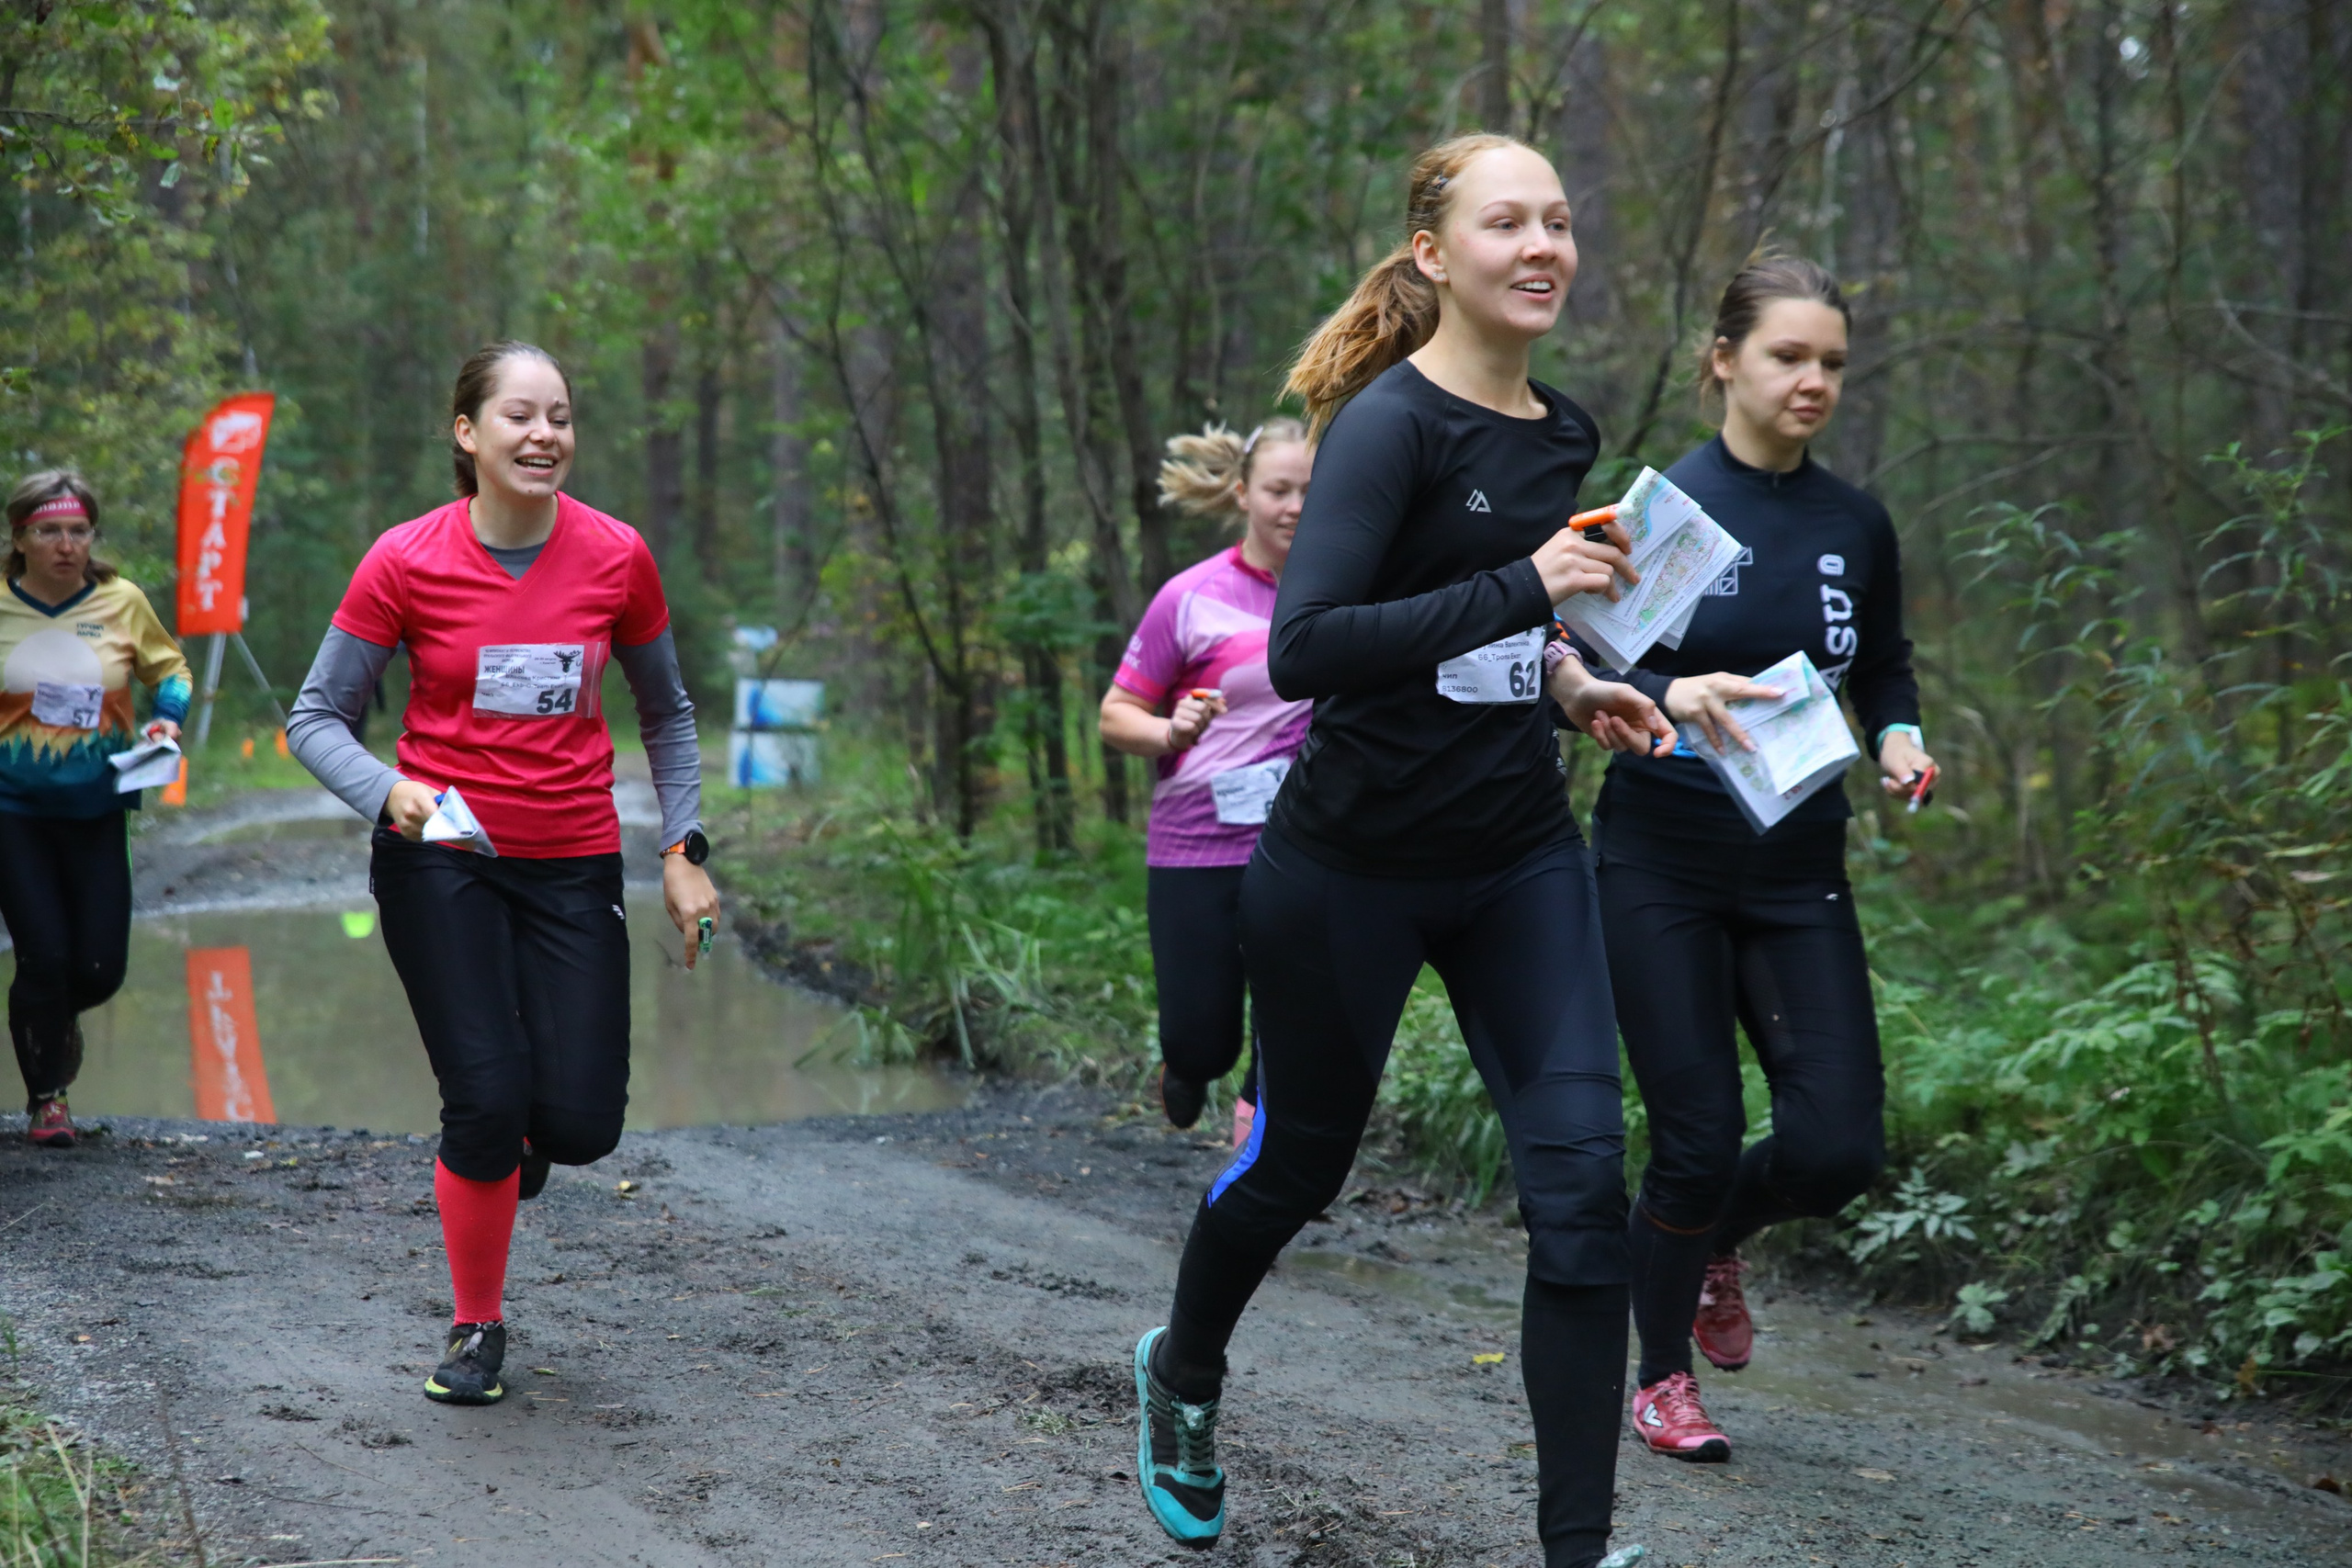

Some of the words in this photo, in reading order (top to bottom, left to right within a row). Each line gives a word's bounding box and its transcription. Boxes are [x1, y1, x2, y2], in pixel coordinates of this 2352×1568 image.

[484, 665, 525, 674] ЖЕНЩИНЫ
[1510, 660, 1536, 698] 62
[537, 688, 572, 714] 54
[73, 707, 96, 728] 57
